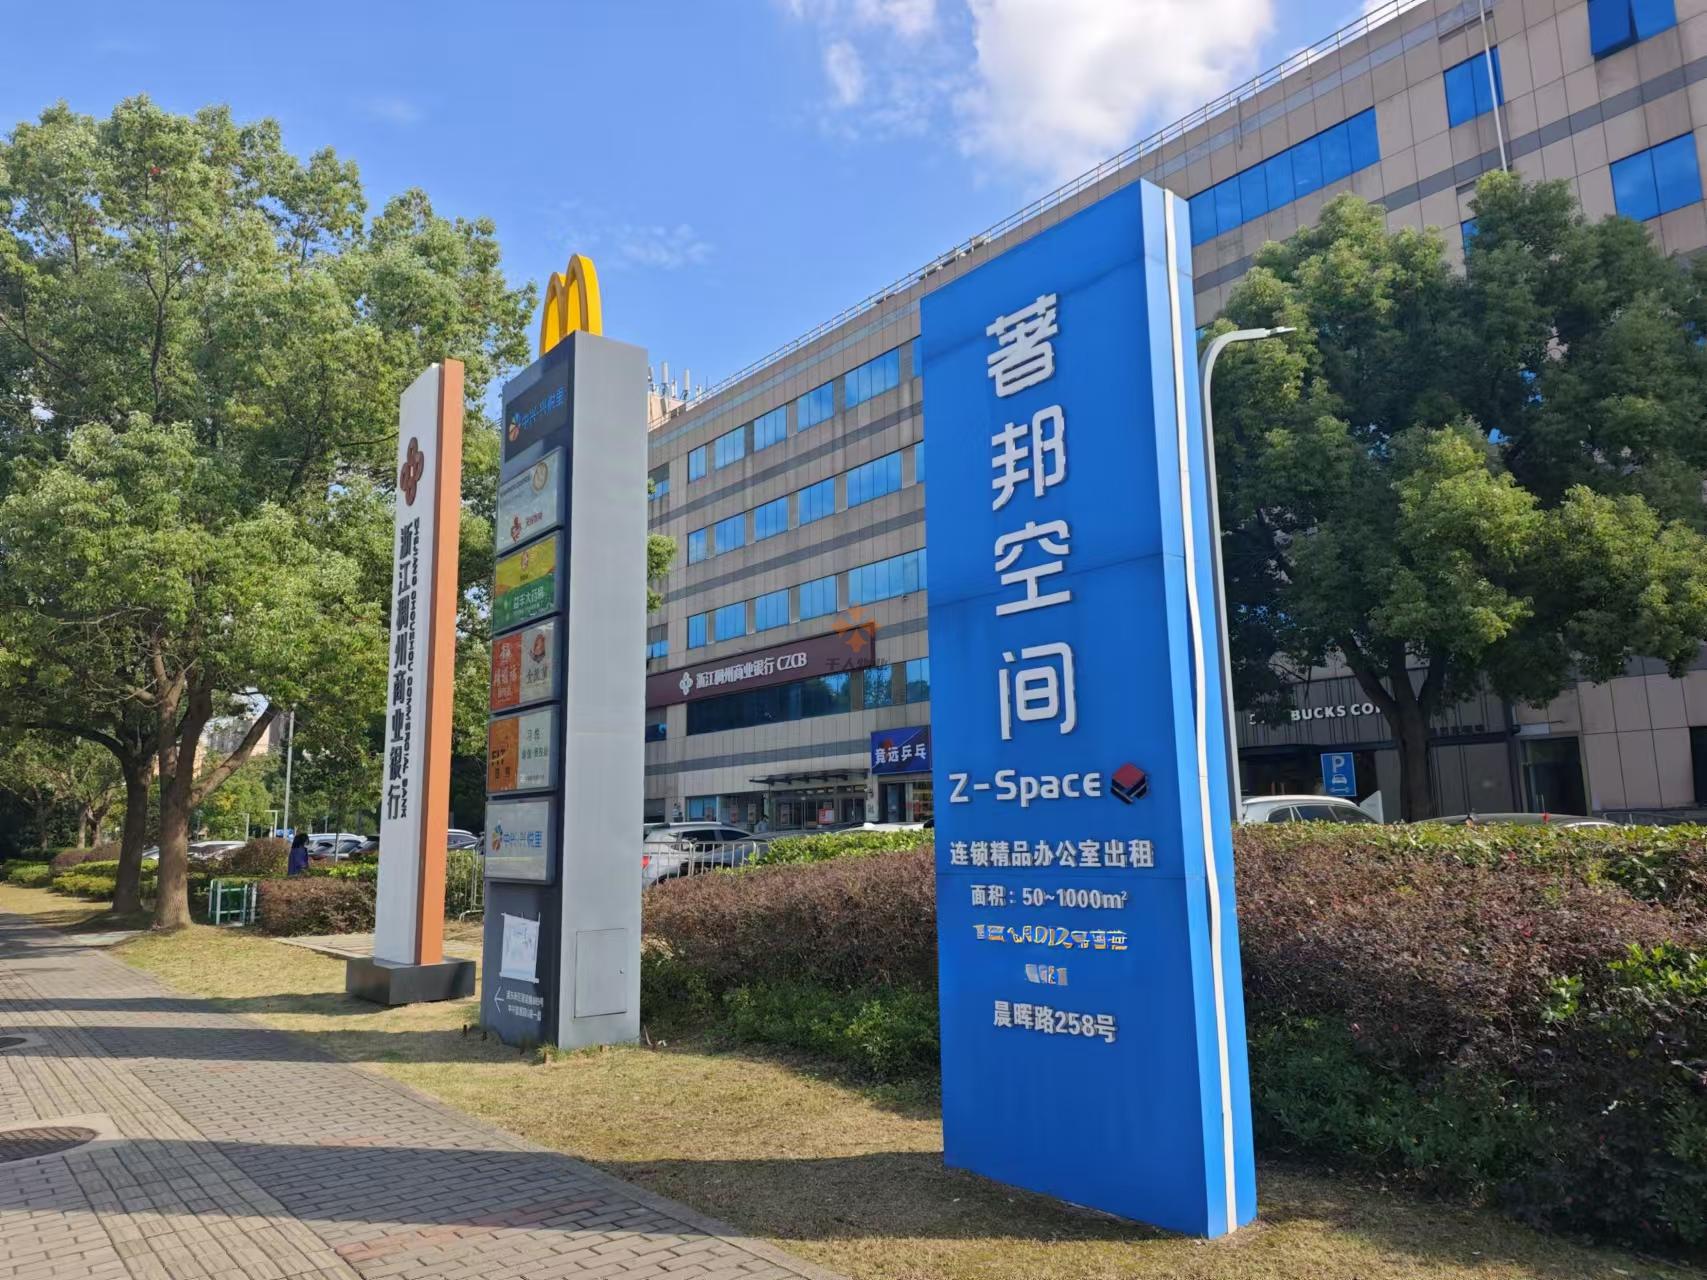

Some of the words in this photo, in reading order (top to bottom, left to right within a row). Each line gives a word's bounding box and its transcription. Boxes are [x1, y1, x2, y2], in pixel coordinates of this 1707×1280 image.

[986, 294, 1076, 740] 著邦空间
[387, 521, 413, 820] 浙江稠州商业银行
[696, 657, 775, 689] 浙江稠州商业银行
[777, 652, 807, 671] CZCB
[402, 676, 413, 774] COMMERCIAL
[1331, 755, 1345, 773] P
[400, 778, 409, 819] BANK
[948, 769, 1102, 808] Z-Space
[950, 839, 1154, 868] 连锁精品办公室出租
[993, 1000, 1117, 1044] 晨晖路258号
